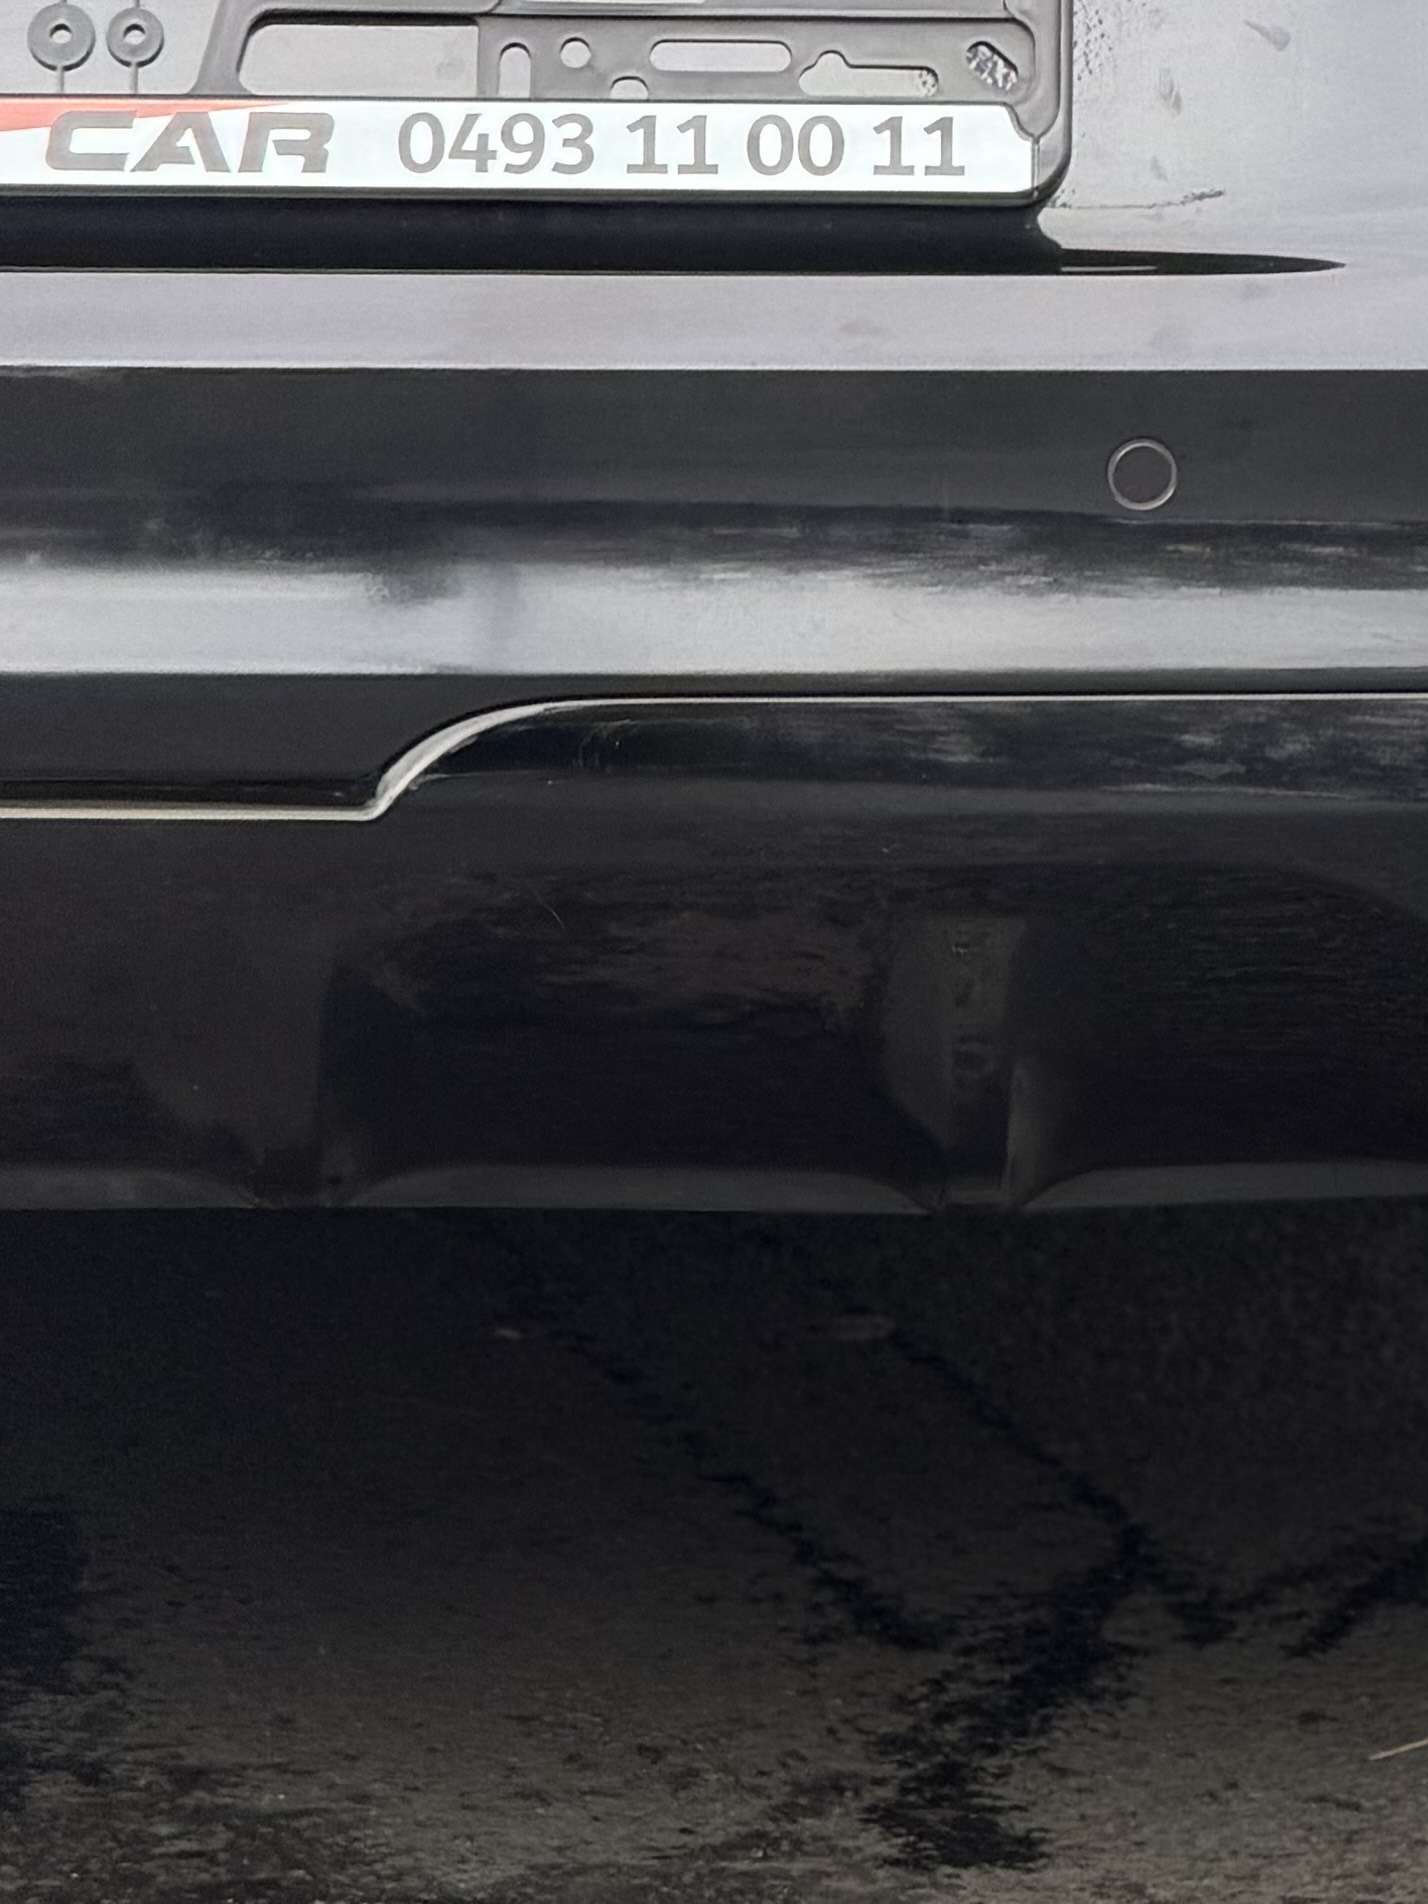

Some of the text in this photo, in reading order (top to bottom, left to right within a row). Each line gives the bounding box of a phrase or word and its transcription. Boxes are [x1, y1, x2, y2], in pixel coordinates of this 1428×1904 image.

[44, 110, 966, 176] CAR 0493 11 00 11
